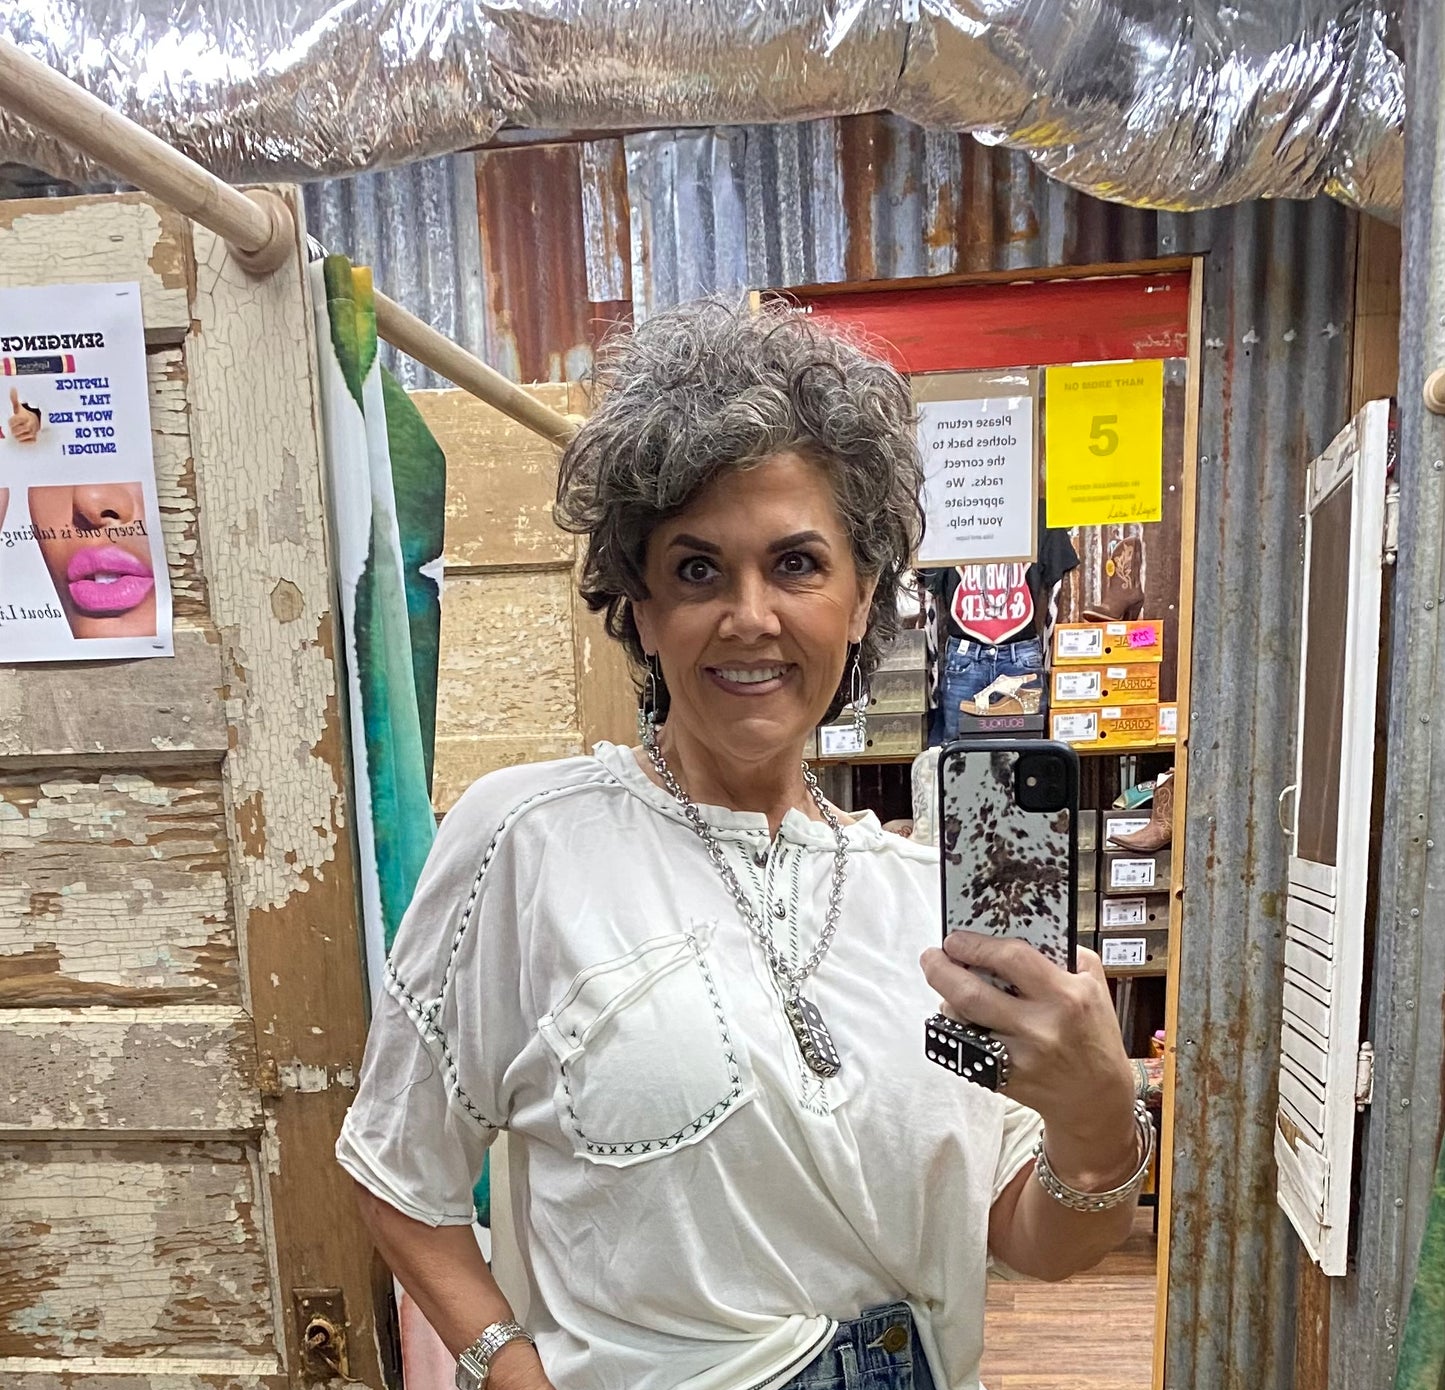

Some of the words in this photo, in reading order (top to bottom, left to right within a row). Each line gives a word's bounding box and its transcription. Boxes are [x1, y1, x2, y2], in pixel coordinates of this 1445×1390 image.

[1064, 382, 1079, 392] NO
[1082, 379, 1112, 390] MORE
[1114, 377, 1144, 388] THAN
[1088, 414, 1119, 457] 5
